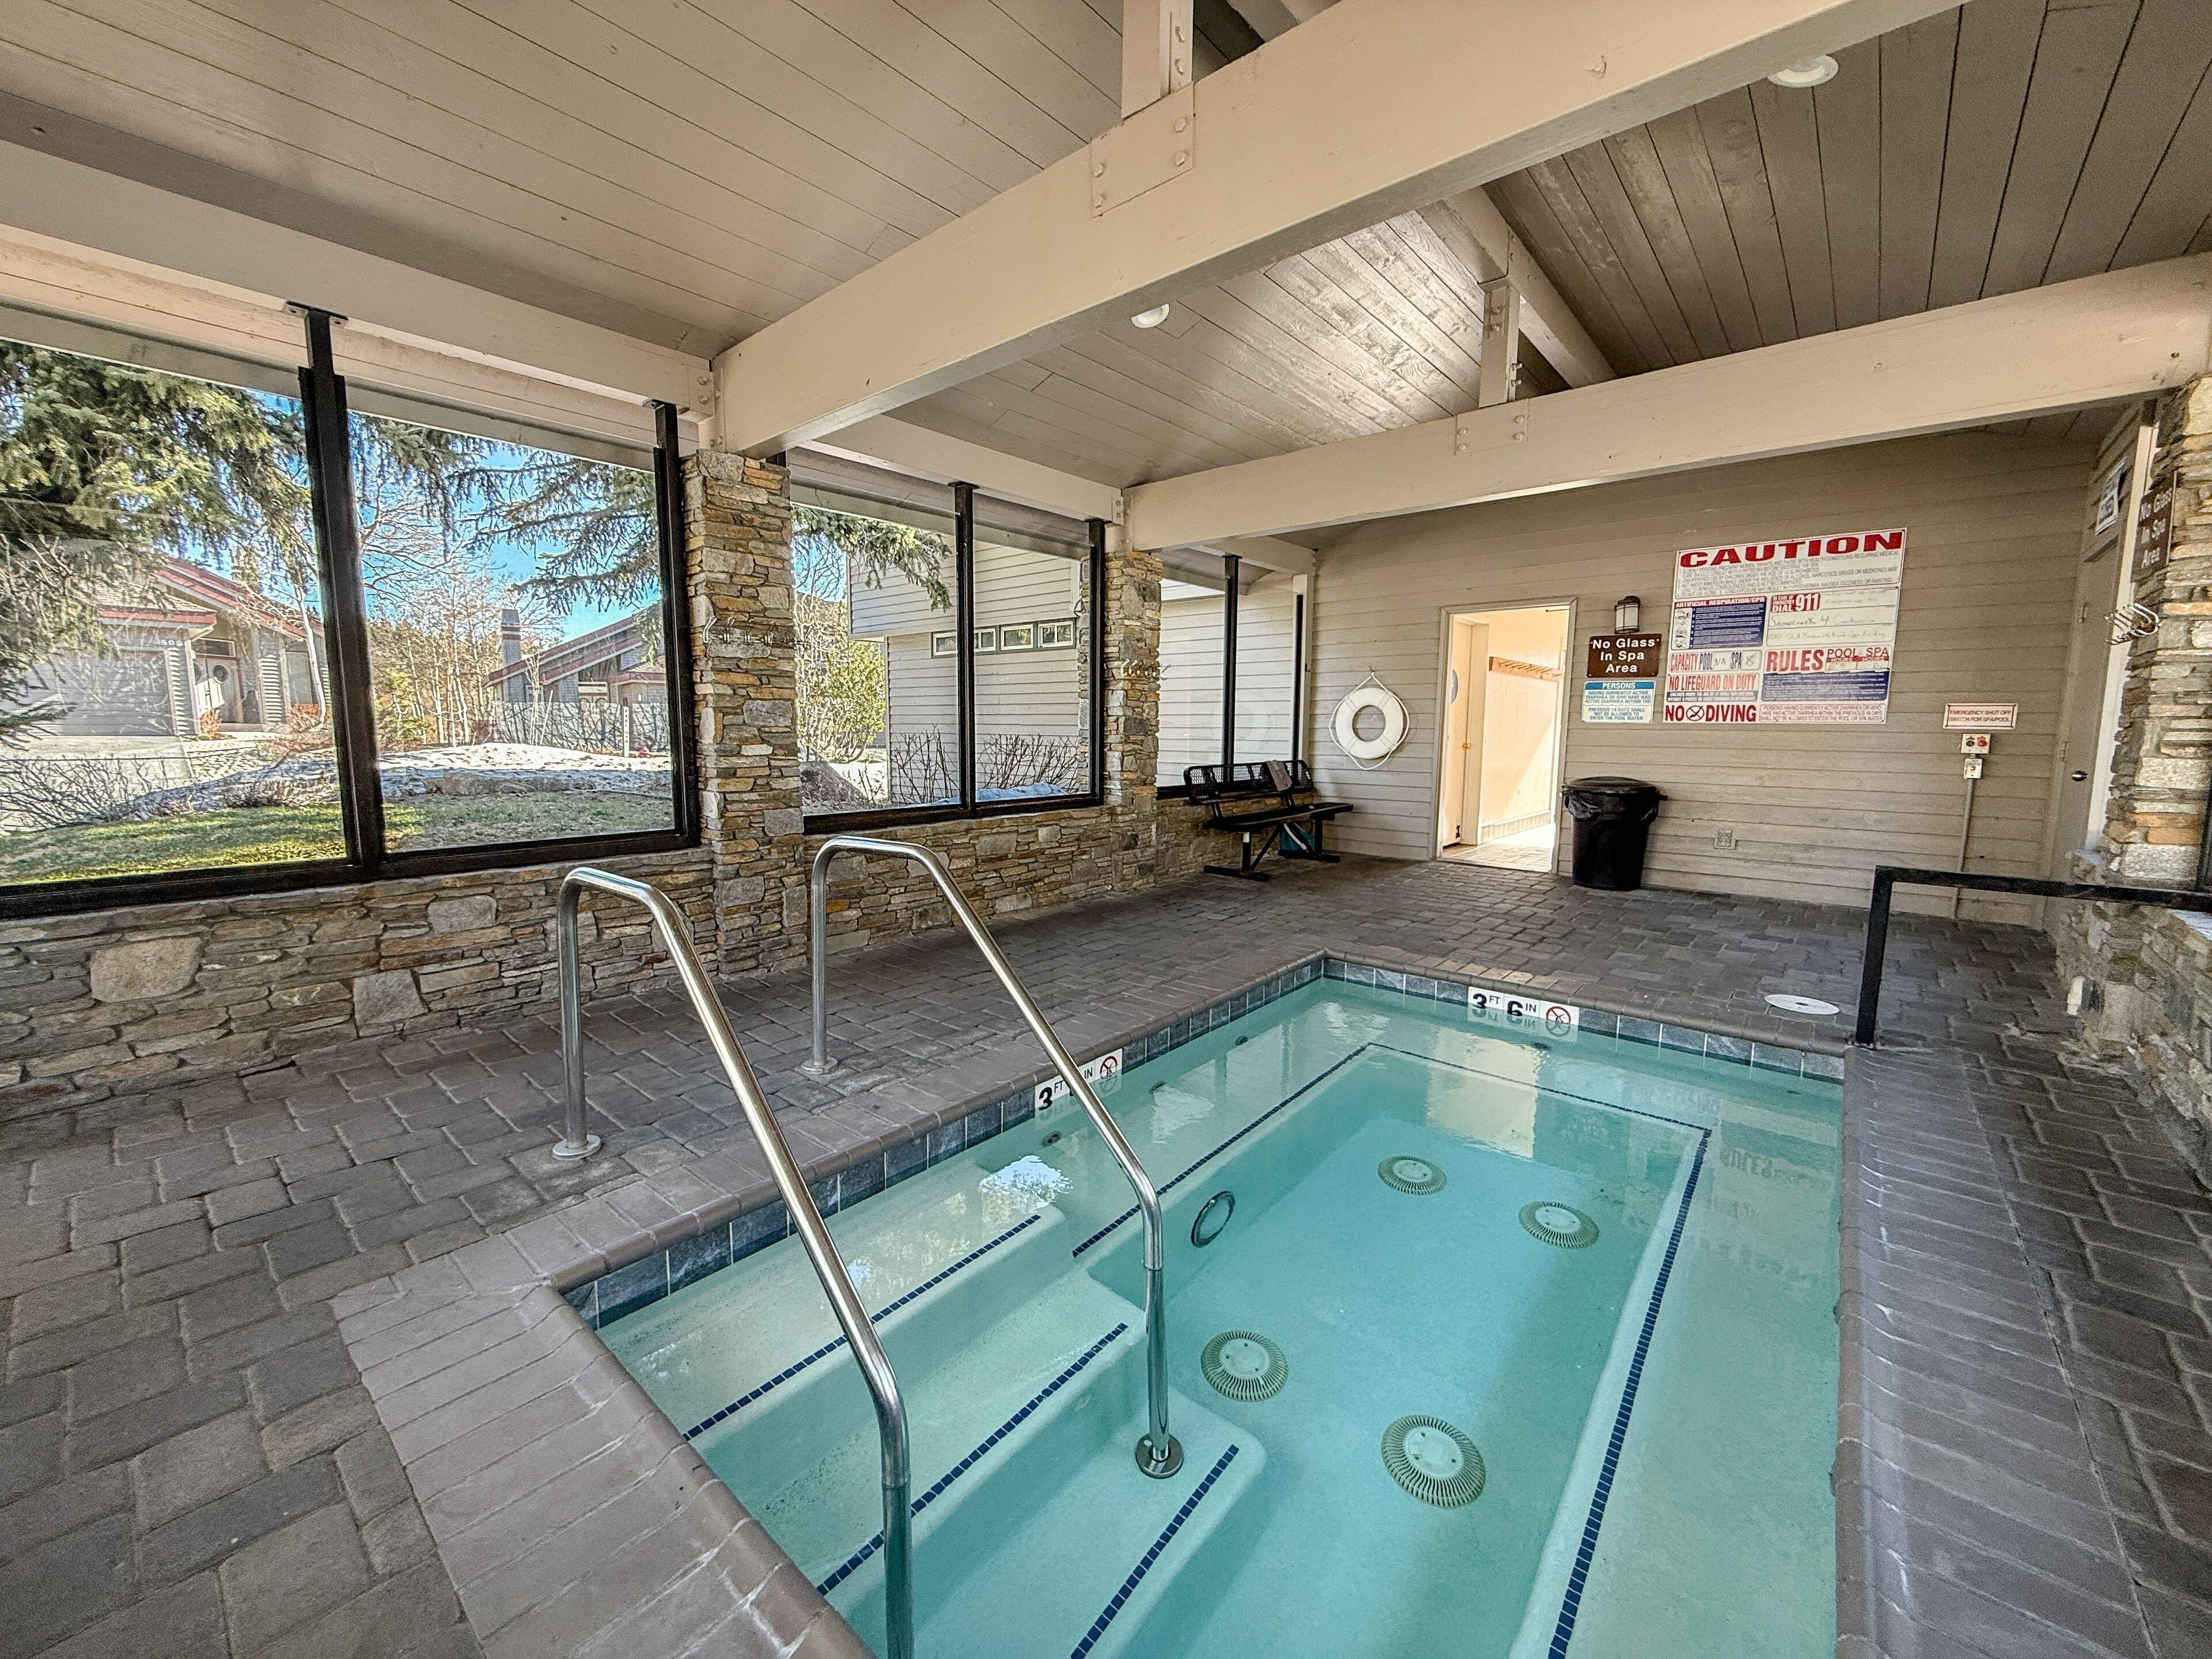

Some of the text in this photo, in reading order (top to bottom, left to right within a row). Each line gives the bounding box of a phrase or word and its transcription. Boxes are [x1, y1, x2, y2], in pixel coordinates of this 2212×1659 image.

[1680, 532, 1903, 568] CAUTION
[1709, 597, 1765, 605] RESPIRATION/CPR
[1772, 604, 1794, 613] DIAL
[1795, 593, 1819, 611] 911
[1820, 615, 1830, 626] 4
[1592, 638, 1655, 649] No Glass
[1600, 650, 1645, 662] In Spa
[1827, 648, 1857, 658] POOL
[1866, 647, 1889, 657] SPA
[1605, 663, 1638, 673] Area
[1671, 653, 1713, 671] CAPACITY POOL
[1730, 652, 1742, 669] SPA
[1766, 649, 1824, 672] RULES
[1669, 676, 1679, 691] NO
[1681, 675, 1721, 691] LIFEGUARD
[1724, 675, 1734, 690] ON
[1736, 674, 1756, 690] DUTY
[1665, 704, 1757, 722] NO DIVING
[1472, 993, 1501, 1009] 3 FT
[1507, 1001, 1537, 1016] 6 IN
[1084, 1067, 1093, 1080] IN
[1039, 1087, 1053, 1111] 3
[1054, 1080, 1064, 1093] FT
